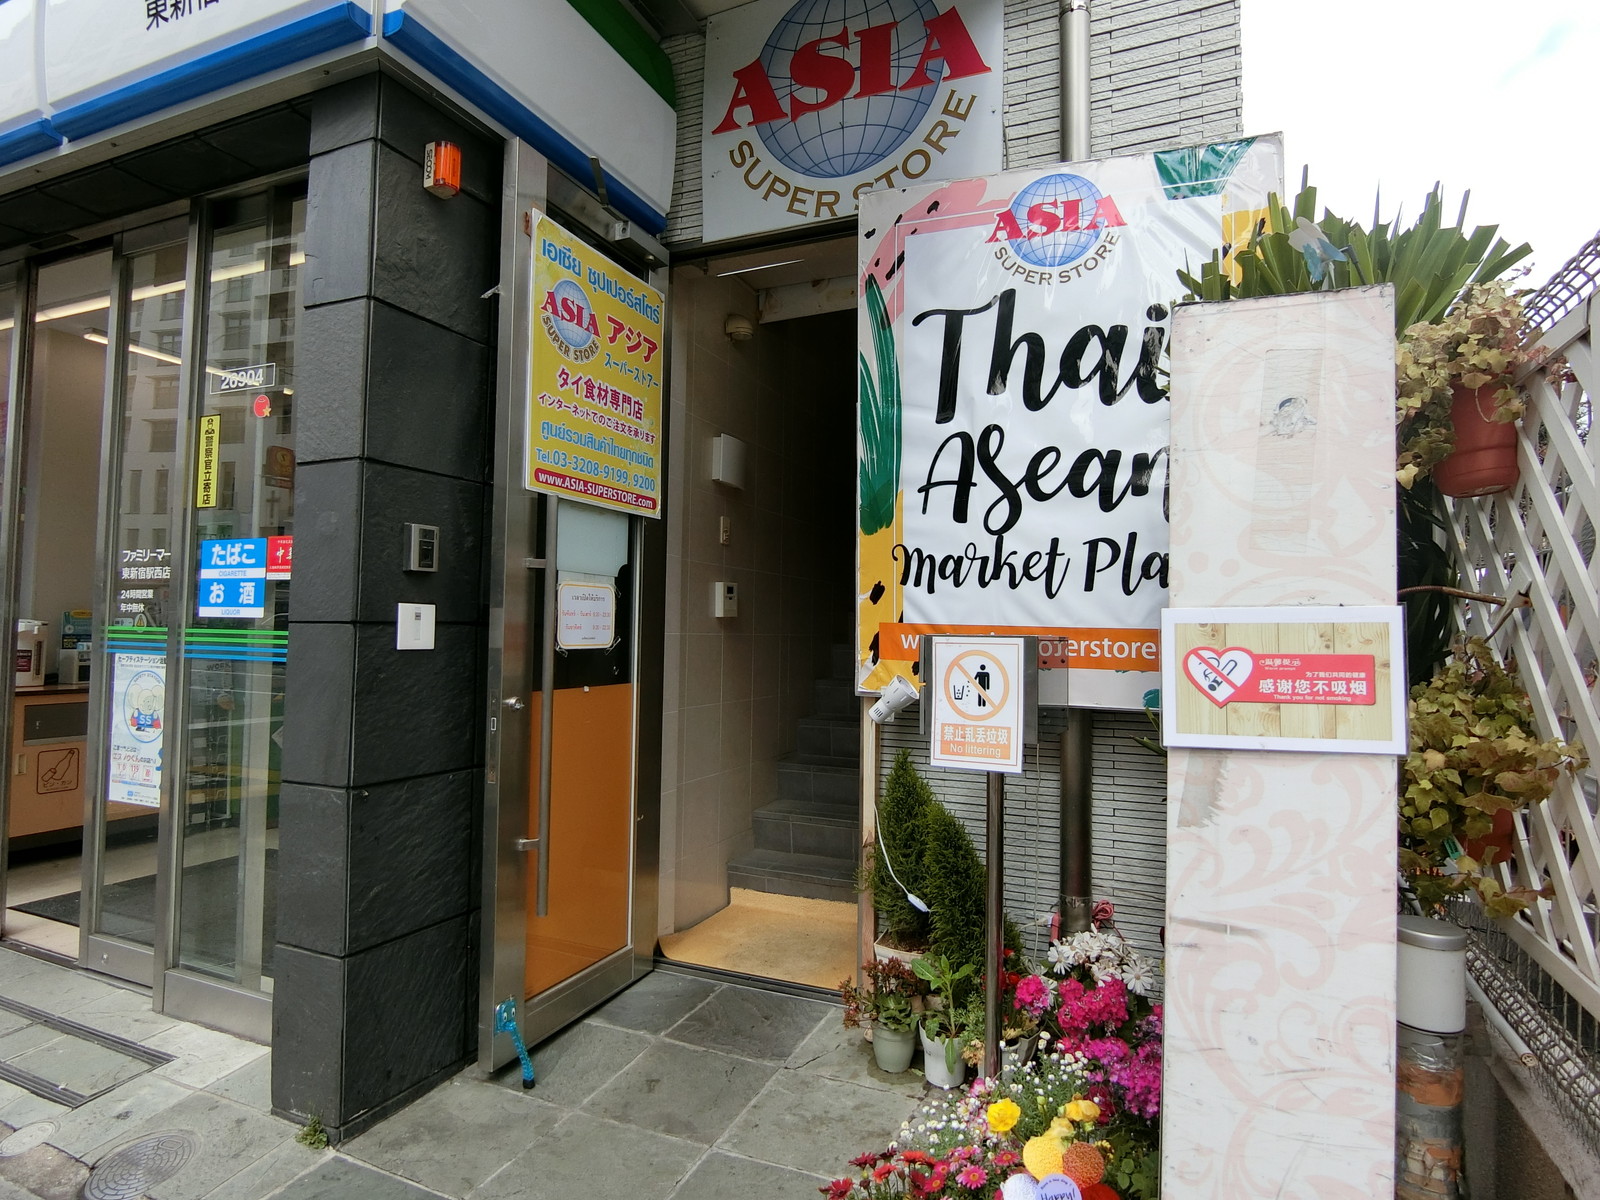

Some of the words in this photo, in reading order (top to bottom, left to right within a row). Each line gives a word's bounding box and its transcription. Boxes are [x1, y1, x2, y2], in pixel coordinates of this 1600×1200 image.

[711, 5, 993, 136] ASIA
[729, 140, 841, 218] SUPER
[985, 194, 1128, 244] ASIA
[994, 246, 1053, 285] SUPER
[1059, 231, 1121, 284] STORE
[541, 291, 601, 339] ASIA
[542, 316, 570, 358] SUPER
[573, 340, 600, 362] STORE
[607, 315, 659, 363] アジア
[912, 288, 1170, 424] Thai
[604, 352, 659, 388] スーパーストアー
[558, 367, 644, 422] タイ食材専門店
[539, 393, 656, 444] インターネットでのご注文を承ります
[538, 472, 654, 509] www.ASIA-SUPERSTORE.com
[633, 473, 656, 492] 9200
[211, 542, 256, 566] たばこ
[121, 566, 172, 580] 東新宿駅西店
[218, 569, 247, 577] CIGARETTE
[221, 608, 241, 616] LIQUOR
[1259, 678, 1367, 695] 感谢您不吸烟
[139, 714, 152, 725] SS
[943, 725, 1008, 745] 禁止乱丢垃圾
[950, 743, 963, 753] No
[965, 744, 1001, 759] littering
